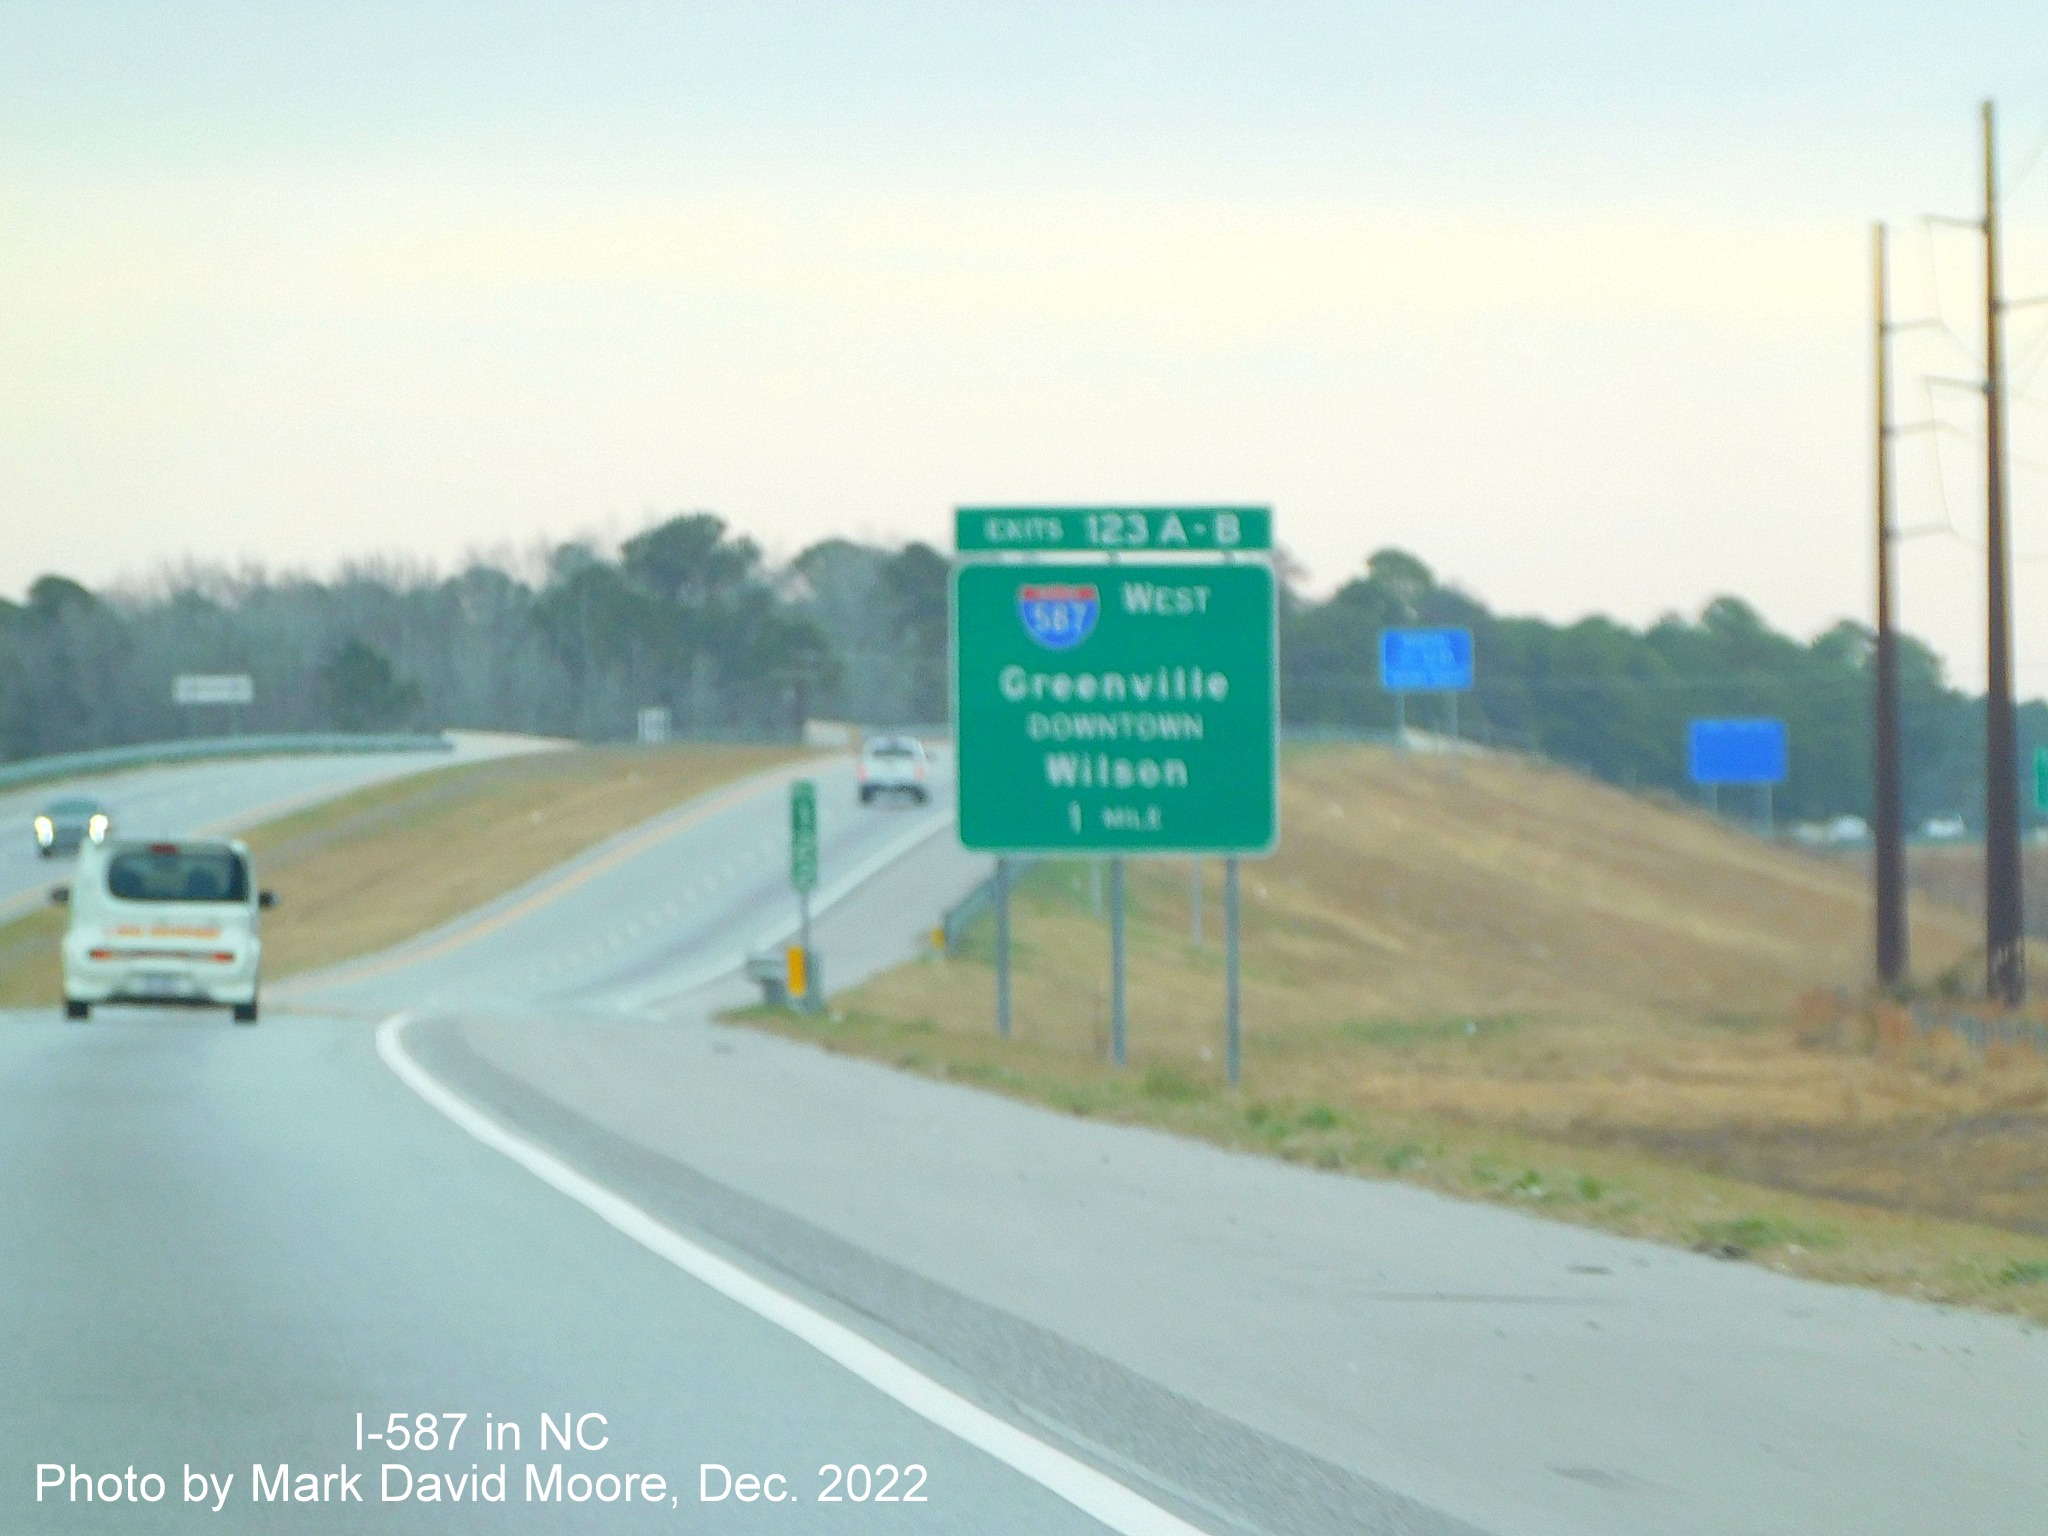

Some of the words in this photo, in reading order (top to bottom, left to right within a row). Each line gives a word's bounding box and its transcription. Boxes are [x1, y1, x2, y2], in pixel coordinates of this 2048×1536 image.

[984, 517, 1063, 541] EXITS
[1086, 512, 1149, 545] 123
[1032, 601, 1088, 632] 587
[1001, 665, 1229, 700] Greenville
[1027, 712, 1203, 740] DOWNTOWN
[1045, 753, 1189, 787] Wilson
[1068, 801, 1082, 833] 1
[1102, 806, 1162, 829] MILE
